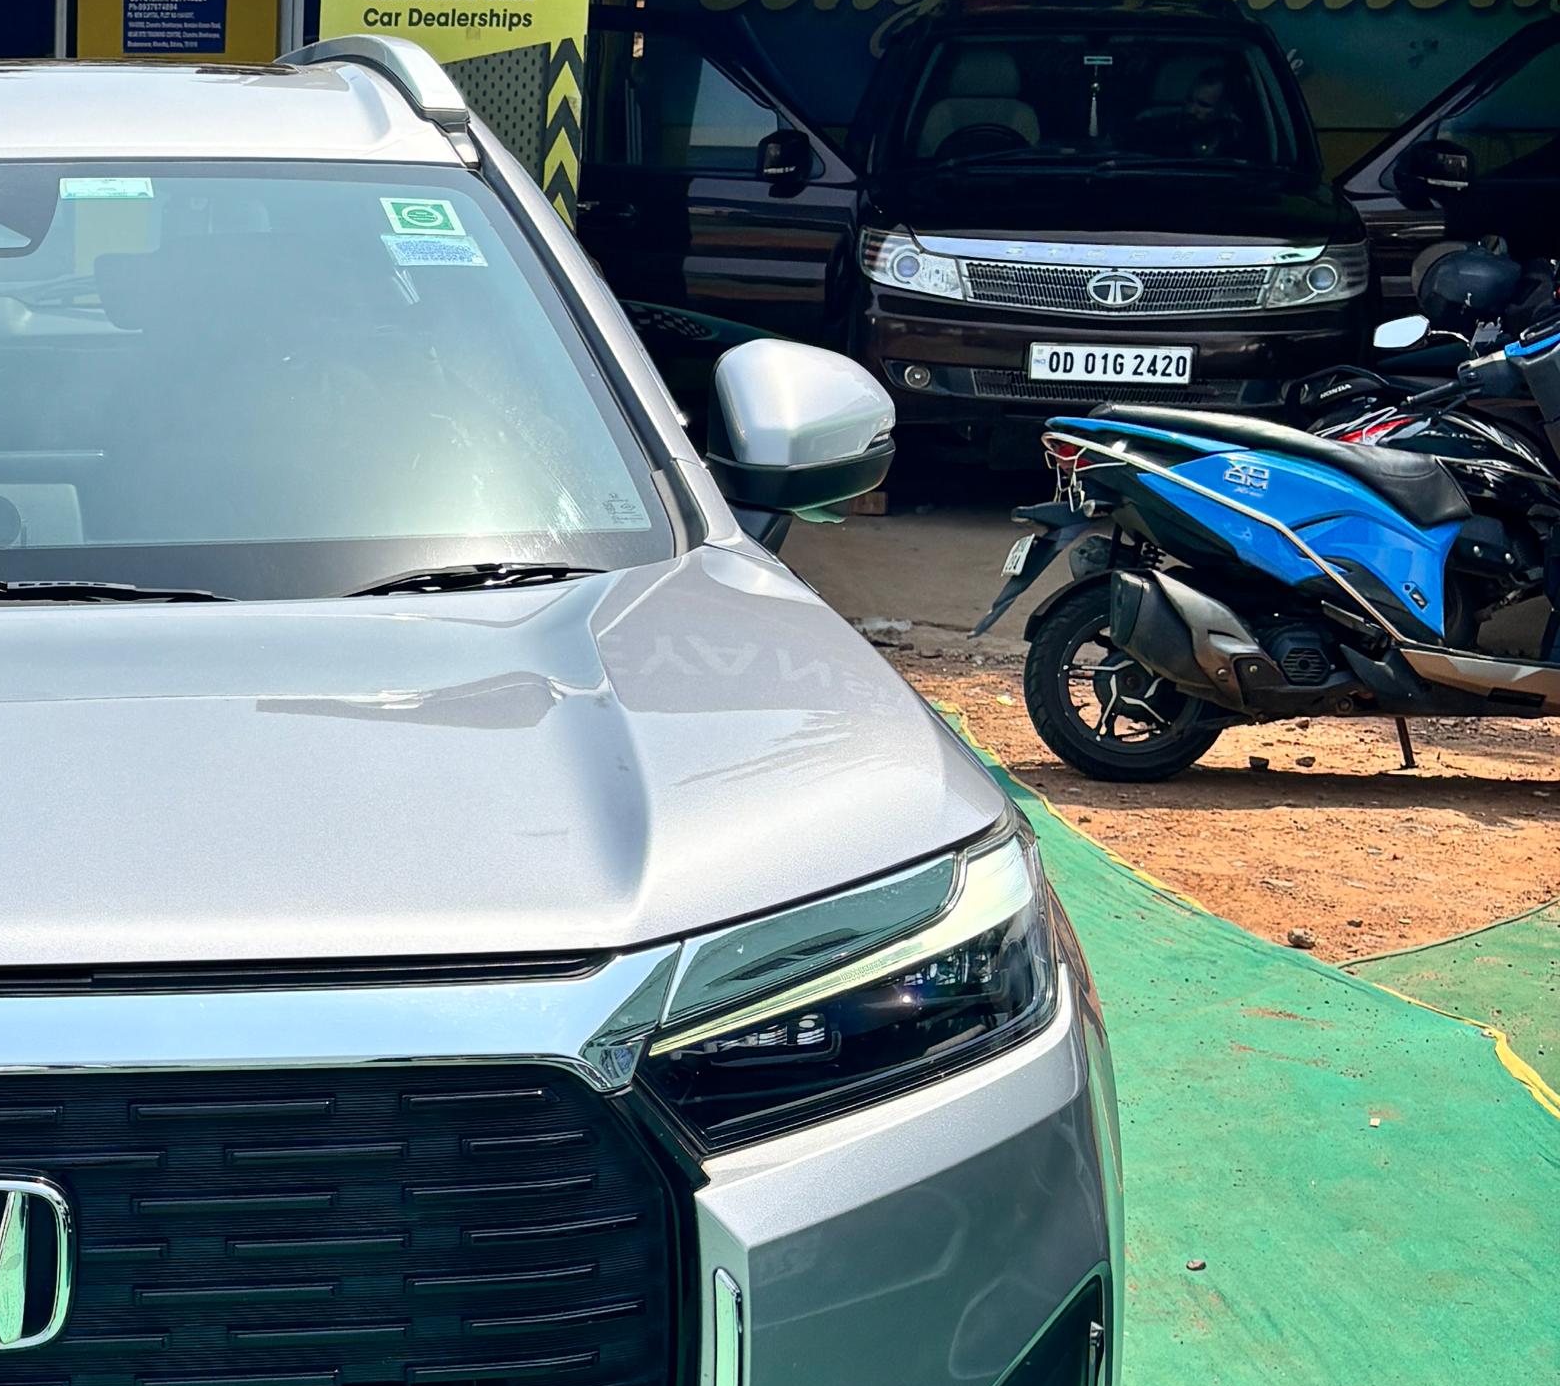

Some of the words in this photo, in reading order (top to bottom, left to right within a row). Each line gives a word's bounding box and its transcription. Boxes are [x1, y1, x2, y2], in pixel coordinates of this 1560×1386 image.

[363, 7, 402, 28] Car
[408, 7, 533, 32] Dealerships
[1132, 354, 1188, 377] 2420
[1320, 383, 1352, 399] HONDA
